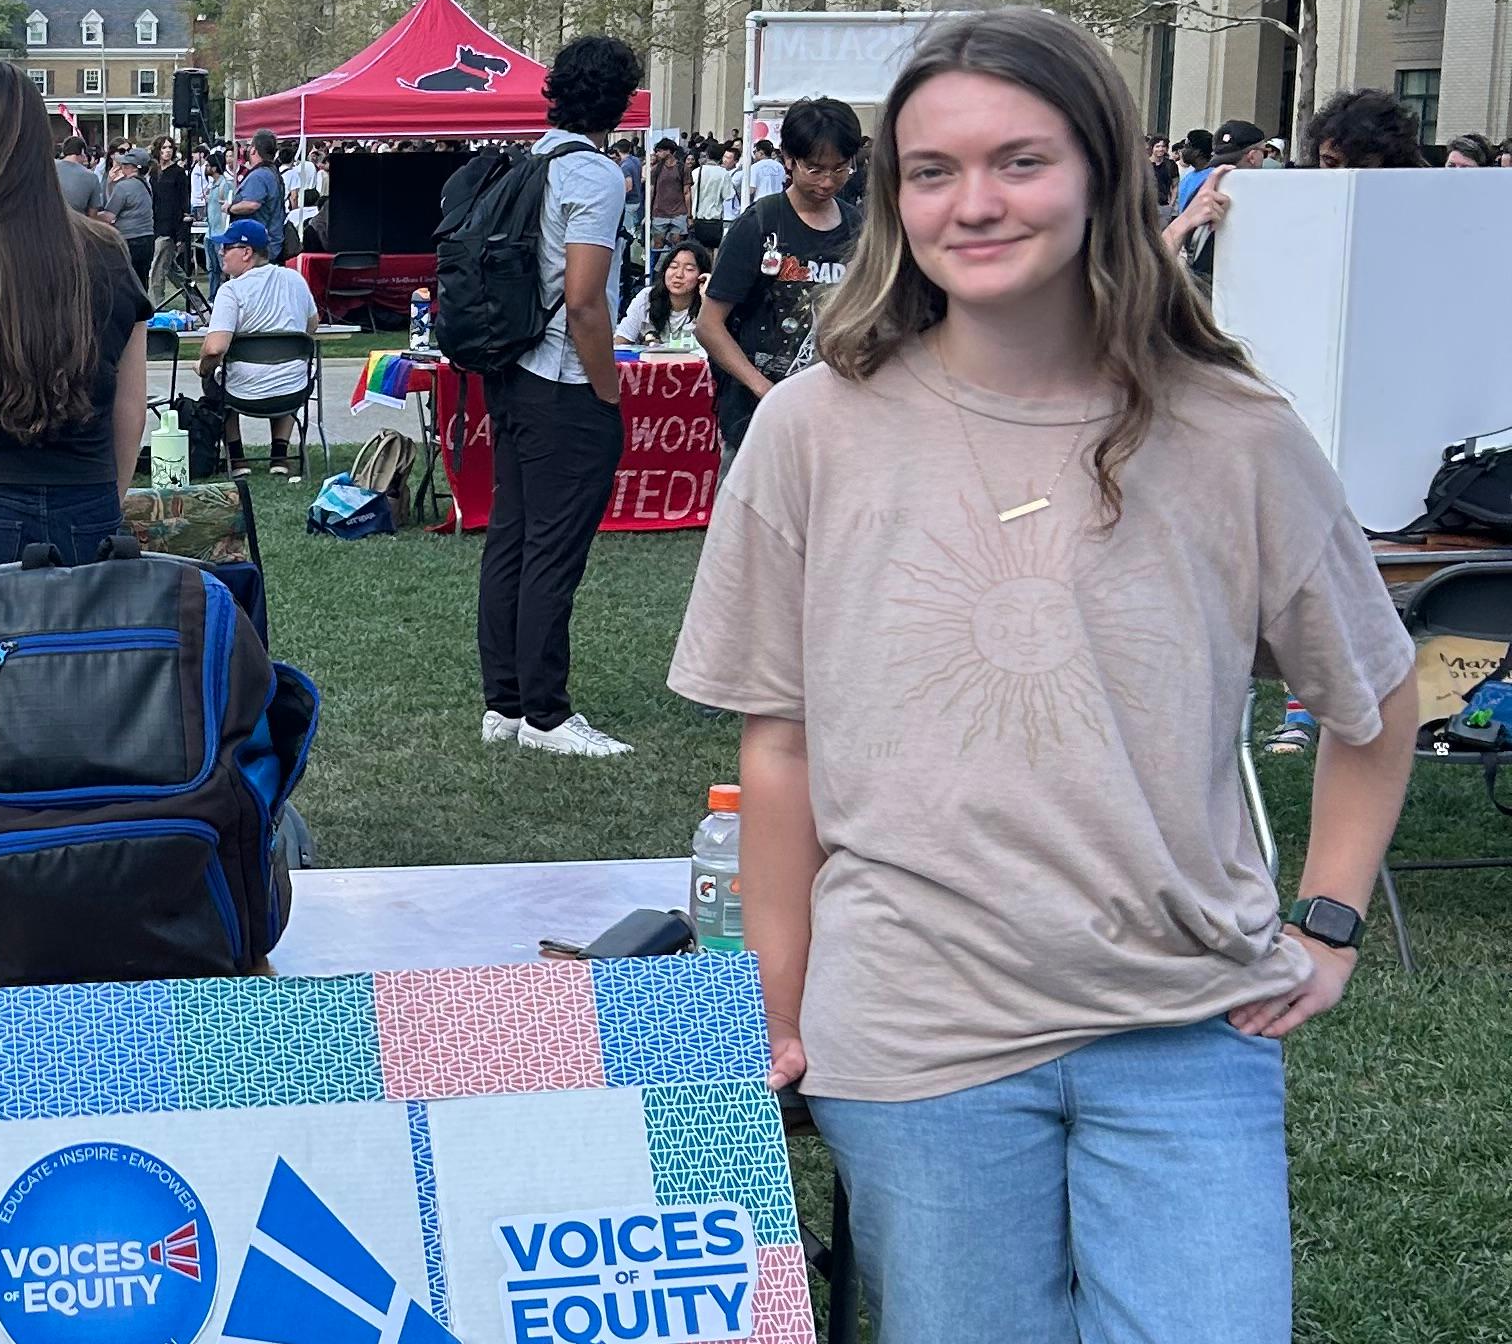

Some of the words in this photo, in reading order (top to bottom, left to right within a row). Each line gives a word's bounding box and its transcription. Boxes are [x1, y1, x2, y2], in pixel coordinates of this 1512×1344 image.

[612, 469, 714, 521] TED!
[60, 1147, 119, 1166] INSPIRE
[129, 1152, 197, 1213] EMPOWER
[0, 1241, 145, 1279] VOICES
[500, 1208, 744, 1272] VOICES
[3, 1291, 20, 1302] OF
[24, 1273, 163, 1317] EQUITY
[615, 1270, 639, 1285] OF
